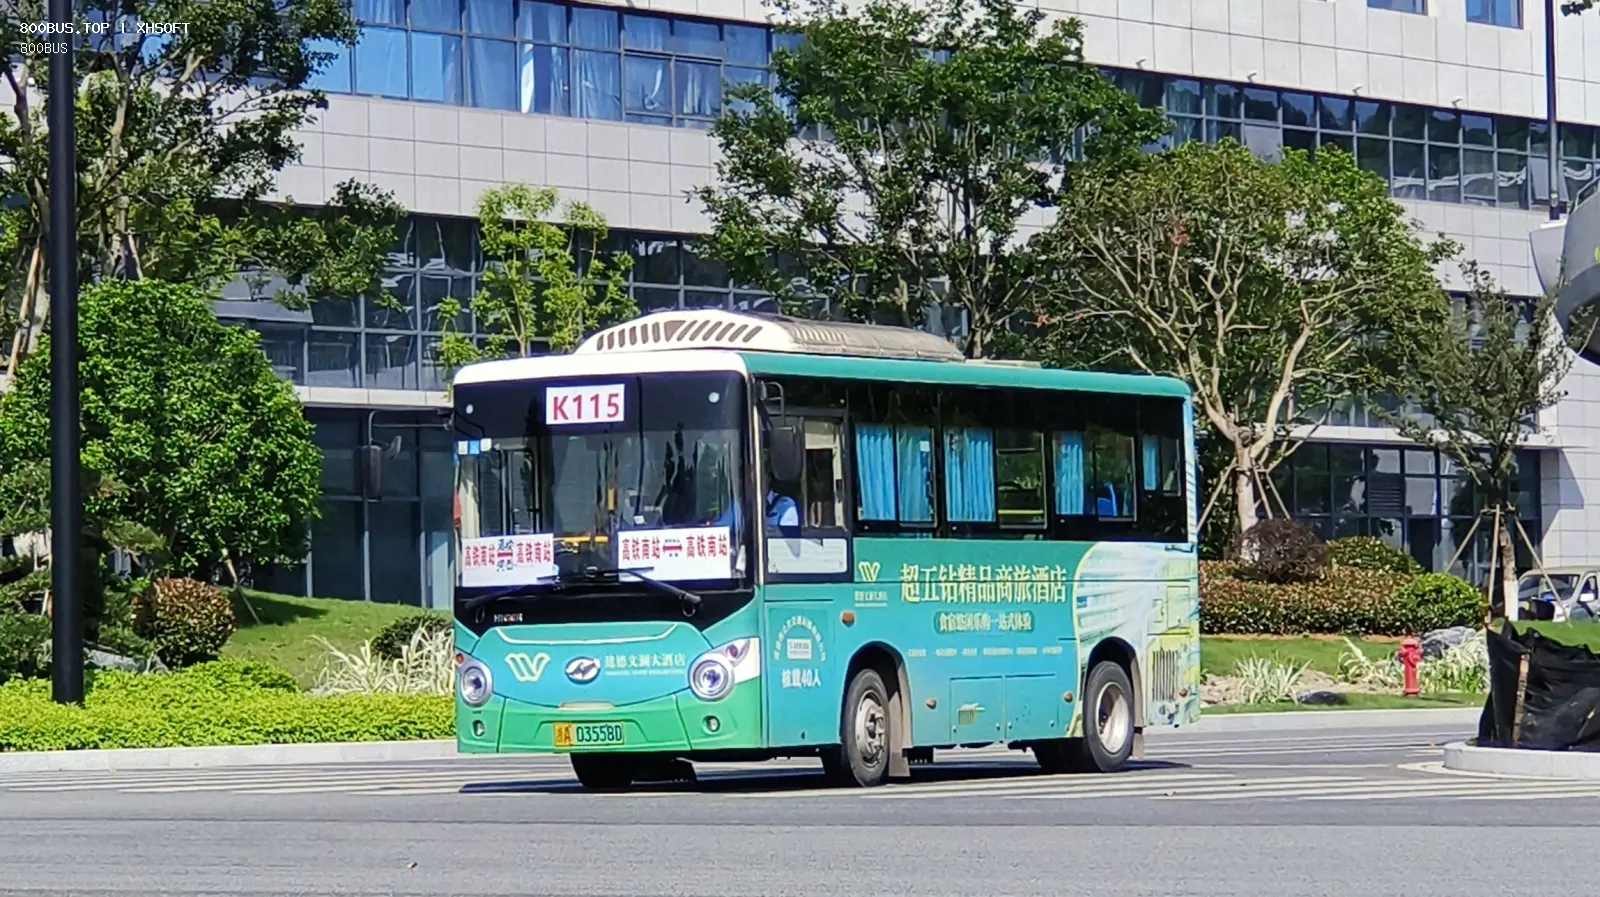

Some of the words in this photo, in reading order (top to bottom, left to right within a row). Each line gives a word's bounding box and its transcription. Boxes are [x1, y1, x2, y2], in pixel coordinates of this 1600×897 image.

[552, 393, 620, 421] K115
[465, 544, 496, 567] 高铁南站
[516, 540, 551, 563] 高铁南站
[622, 536, 661, 560] 高铁南站
[686, 534, 728, 557] 高铁南站
[900, 563, 1068, 604] 超五钻精品商旅酒店
[576, 724, 623, 742] 03558D
